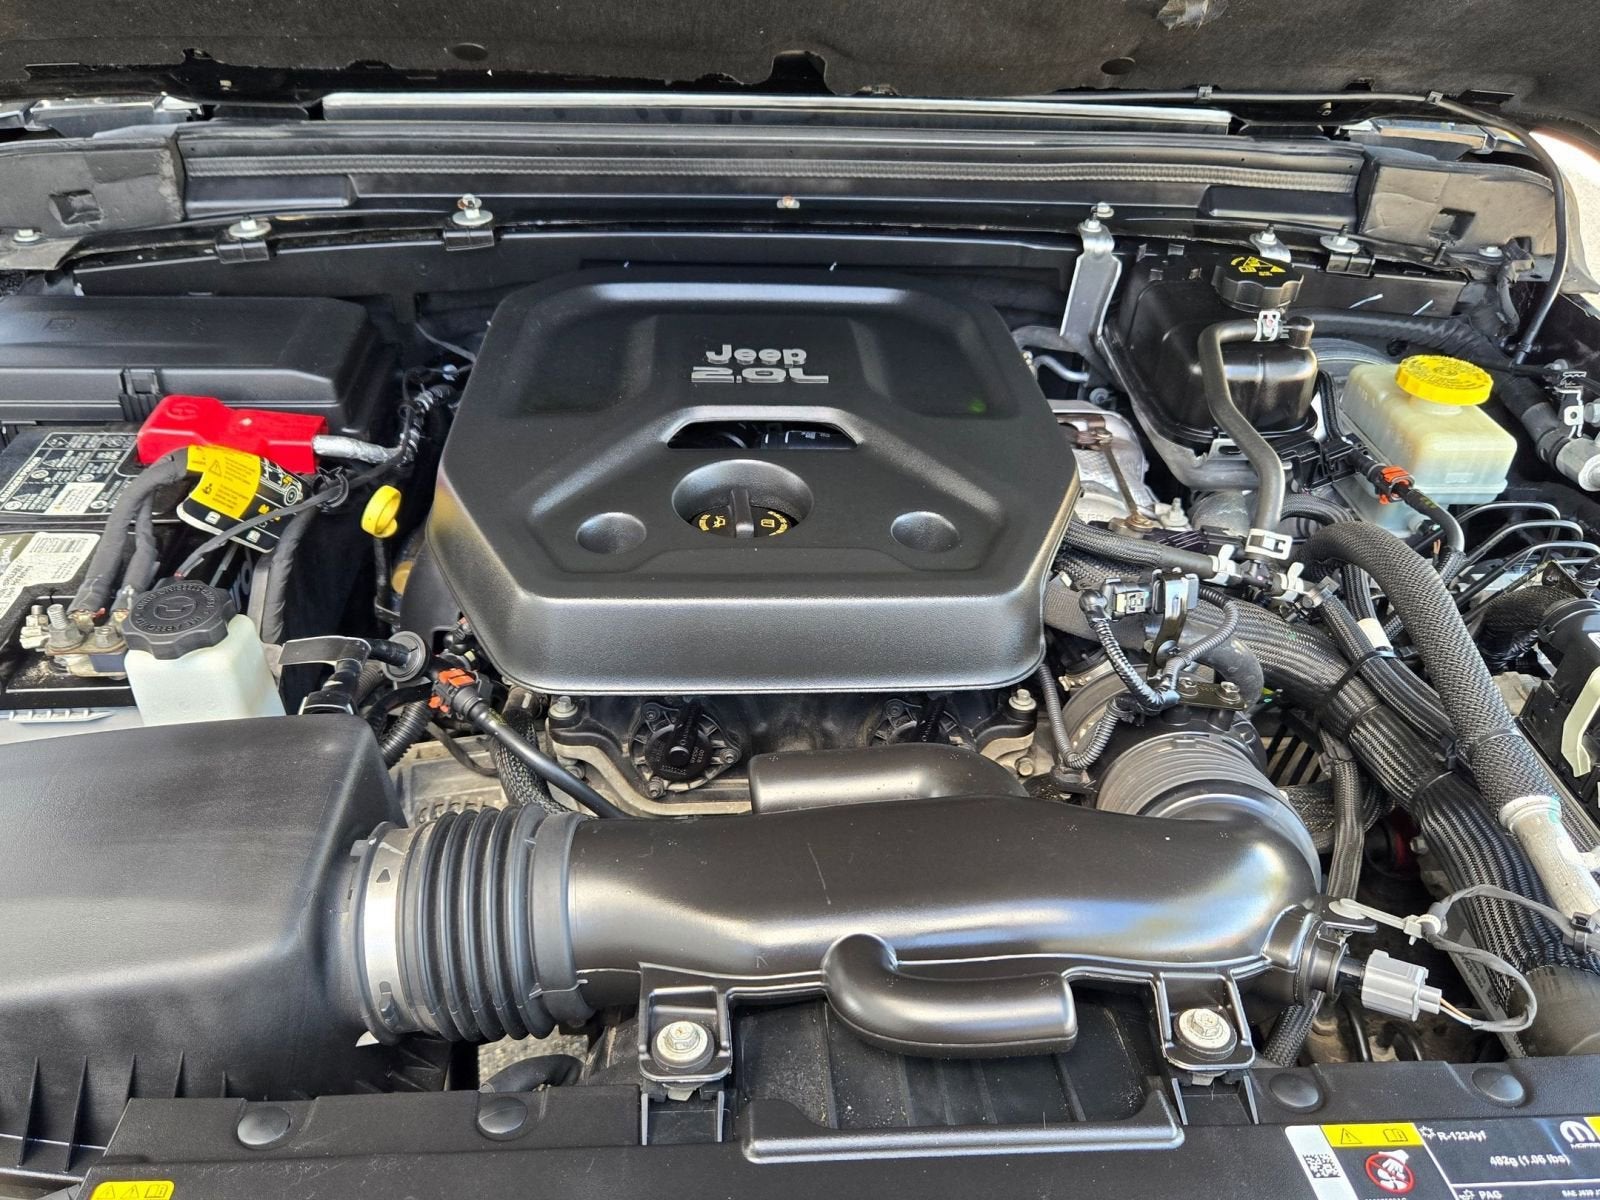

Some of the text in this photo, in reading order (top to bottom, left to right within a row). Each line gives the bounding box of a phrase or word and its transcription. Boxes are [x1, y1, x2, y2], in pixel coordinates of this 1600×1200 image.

[705, 344, 807, 368] Jeep
[691, 366, 829, 384] 2.0L
[1437, 1130, 1487, 1143] R-1234yf
[1479, 1190, 1503, 1200] PAG
